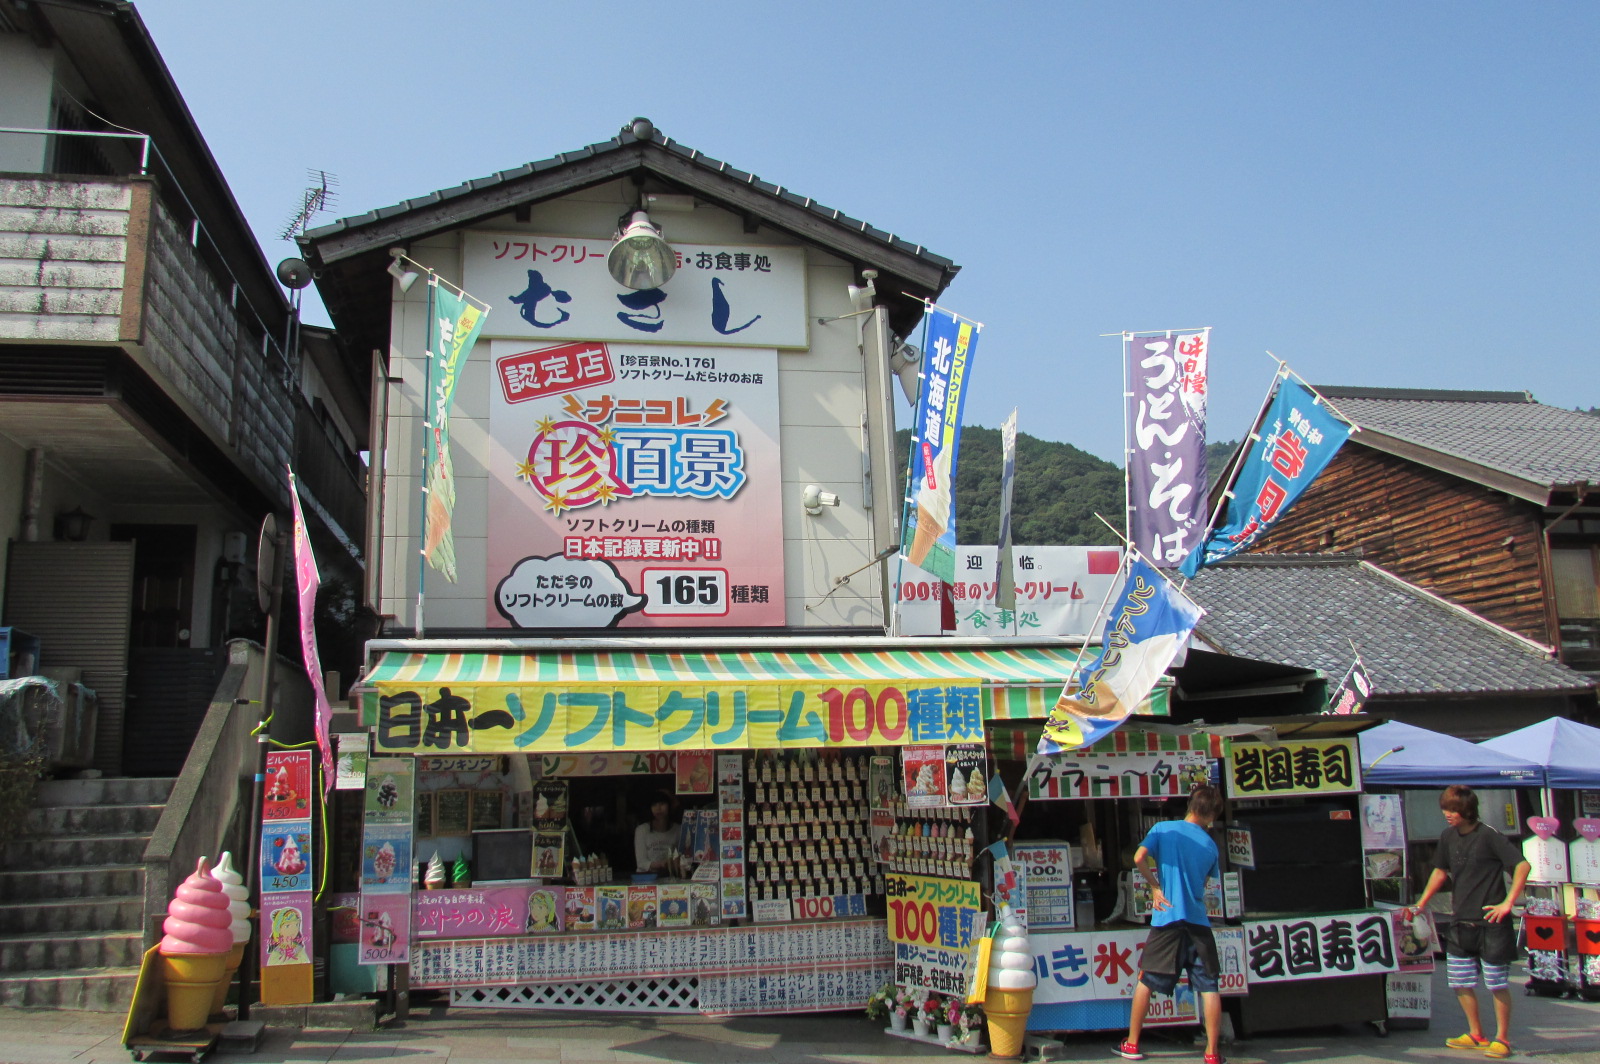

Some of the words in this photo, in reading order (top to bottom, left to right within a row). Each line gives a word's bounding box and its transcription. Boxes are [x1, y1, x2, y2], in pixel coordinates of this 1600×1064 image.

[504, 347, 607, 395] 認定店
[619, 368, 764, 386] ソフトクリームだらけのお店
[1179, 336, 1206, 395] 味自慢
[925, 336, 951, 447] 北海道
[945, 345, 967, 429] ソフトクリーム
[585, 395, 703, 424] ナニコレ
[543, 434, 736, 494] 珍百景
[566, 518, 716, 535] ソフトクリームの種類
[536, 575, 593, 589] ただ今の
[657, 575, 719, 606] 165
[505, 592, 624, 609] ソフトクリームの数
[731, 585, 770, 605] 種類
[267, 756, 307, 766] ビルベリー
[1234, 744, 1354, 793] 岩国寿司
[1227, 830, 1250, 846] かき氷
[886, 877, 980, 906] 日本一ソフトクリーム
[649, 938, 658, 963] コーヒー
[700, 936, 708, 962] ココア
[748, 933, 756, 959] 紅茶
[1249, 915, 1394, 979] 岩国寿司
[475, 946, 484, 973] 豆乳
[748, 976, 757, 1002] にんにく
[758, 976, 768, 1002] 納豆
[768, 976, 777, 1000] しょうゆ
[778, 976, 787, 1000] 七味
[798, 974, 806, 998] カレー
[806, 973, 815, 998] ラーメン
[826, 972, 835, 997] わさび
[835, 972, 845, 997] うめ
[1219, 973, 1245, 990] 300
[1146, 1000, 1174, 1018] 00円
